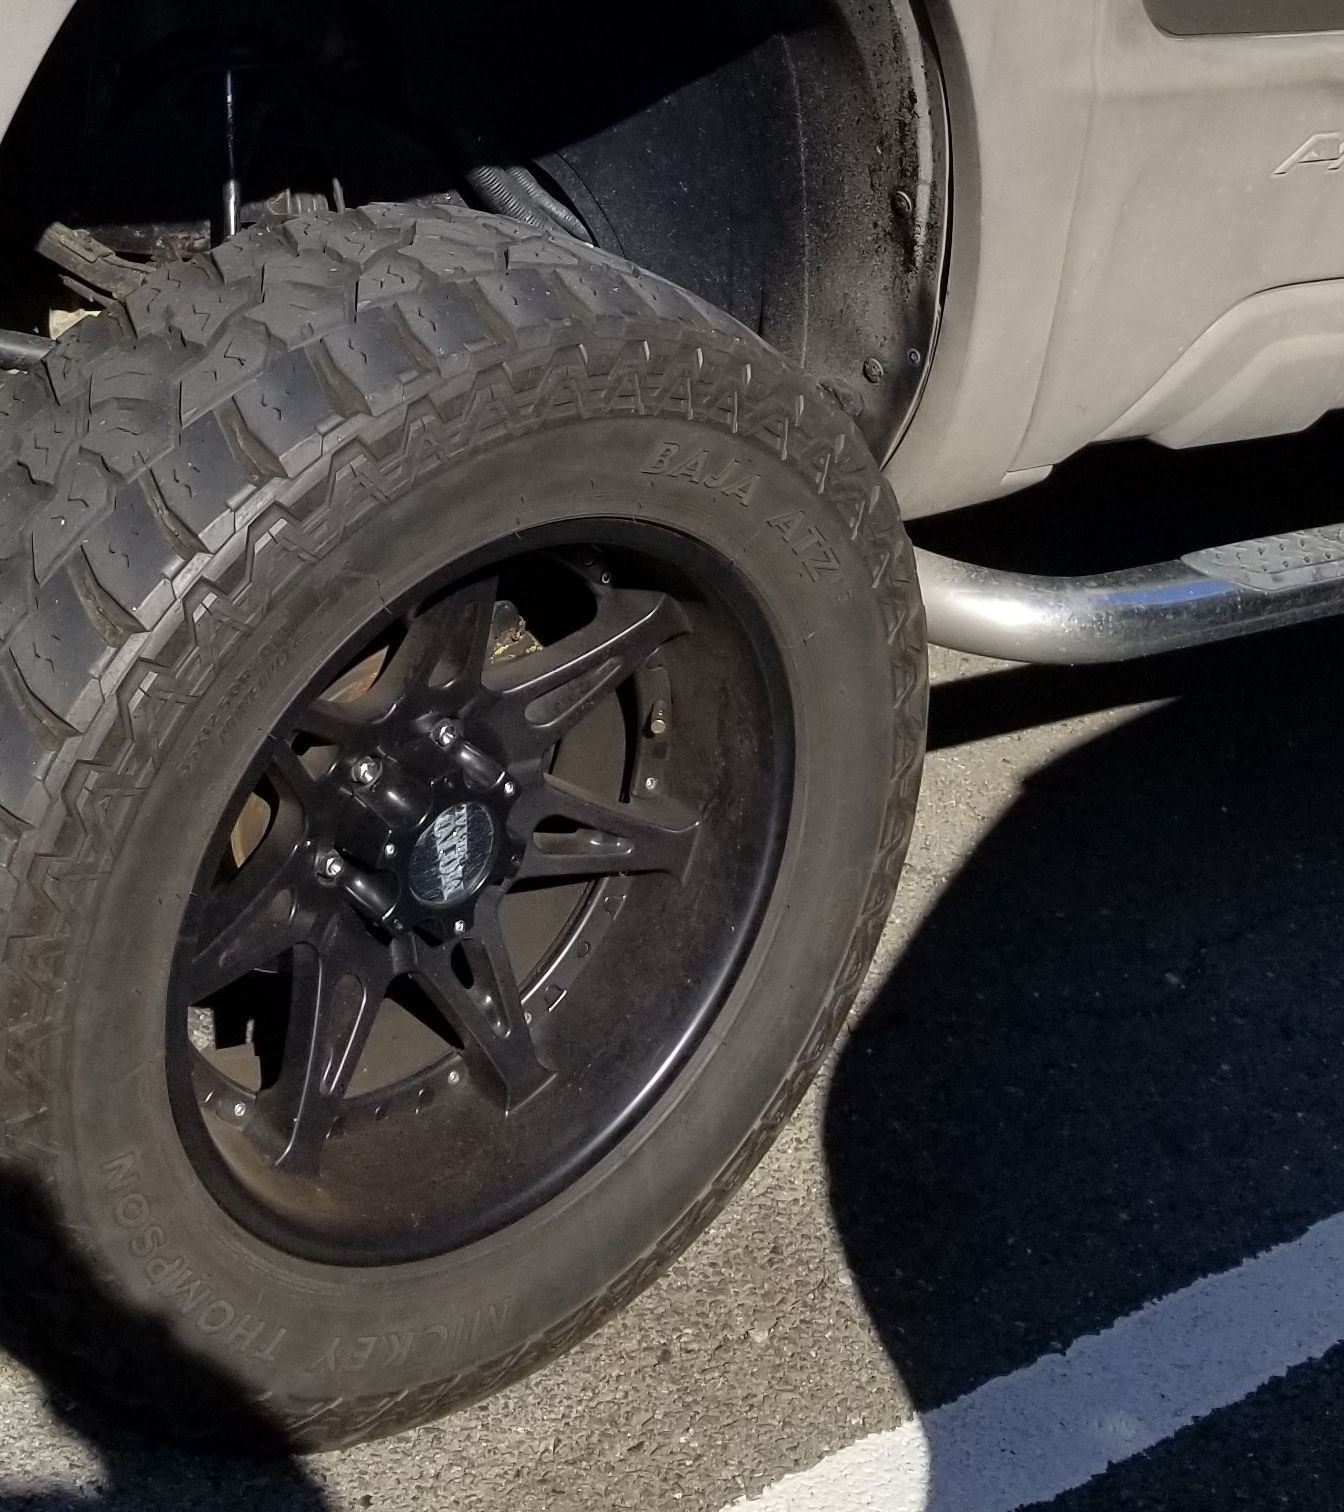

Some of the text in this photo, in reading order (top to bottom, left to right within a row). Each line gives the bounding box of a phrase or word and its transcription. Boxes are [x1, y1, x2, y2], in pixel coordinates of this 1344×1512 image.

[641, 441, 841, 583] BAJA ATZ
[99, 1148, 513, 1373] MICKEY THOMPSON
